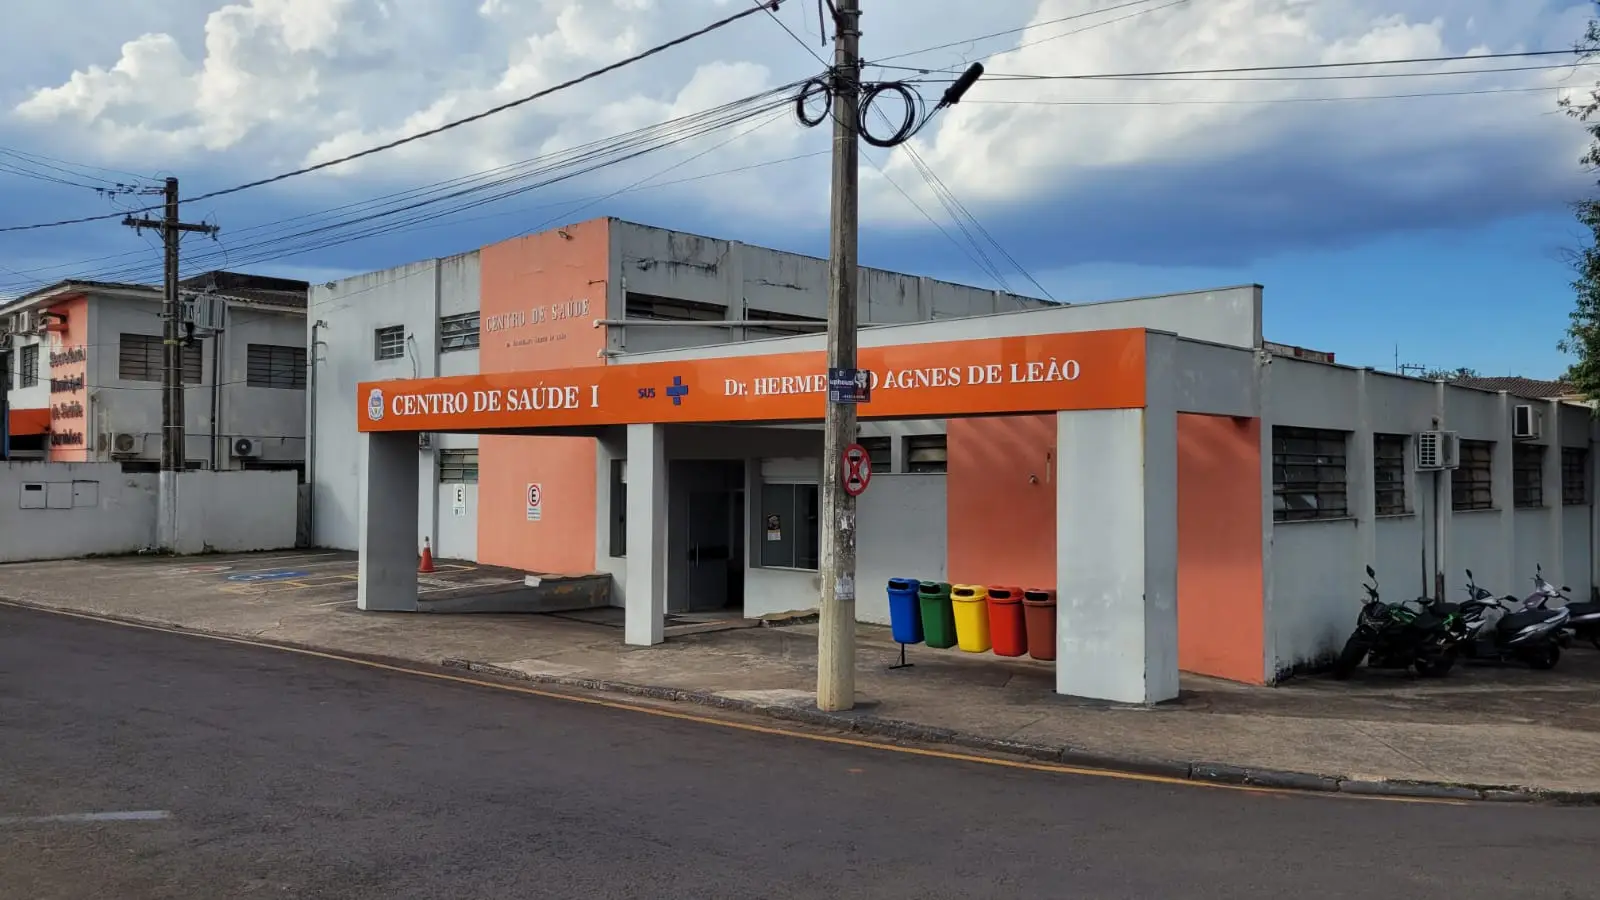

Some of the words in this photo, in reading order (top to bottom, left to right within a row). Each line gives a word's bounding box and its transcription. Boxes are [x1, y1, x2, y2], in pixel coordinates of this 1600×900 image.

[486, 311, 525, 332] CENTRO
[532, 306, 546, 324] DE
[551, 296, 590, 320] SAÚDE
[638, 387, 655, 399] SUS
[724, 378, 748, 397] Dr.
[754, 371, 879, 395] HERMEO
[882, 366, 961, 389] AGNES
[967, 364, 1002, 385] DE
[1010, 357, 1081, 383] LEÃO
[391, 391, 468, 416] CENTRO
[473, 390, 502, 412] DE
[506, 381, 579, 411] SAÚDE
[591, 385, 599, 408] I
[531, 489, 537, 502] E
